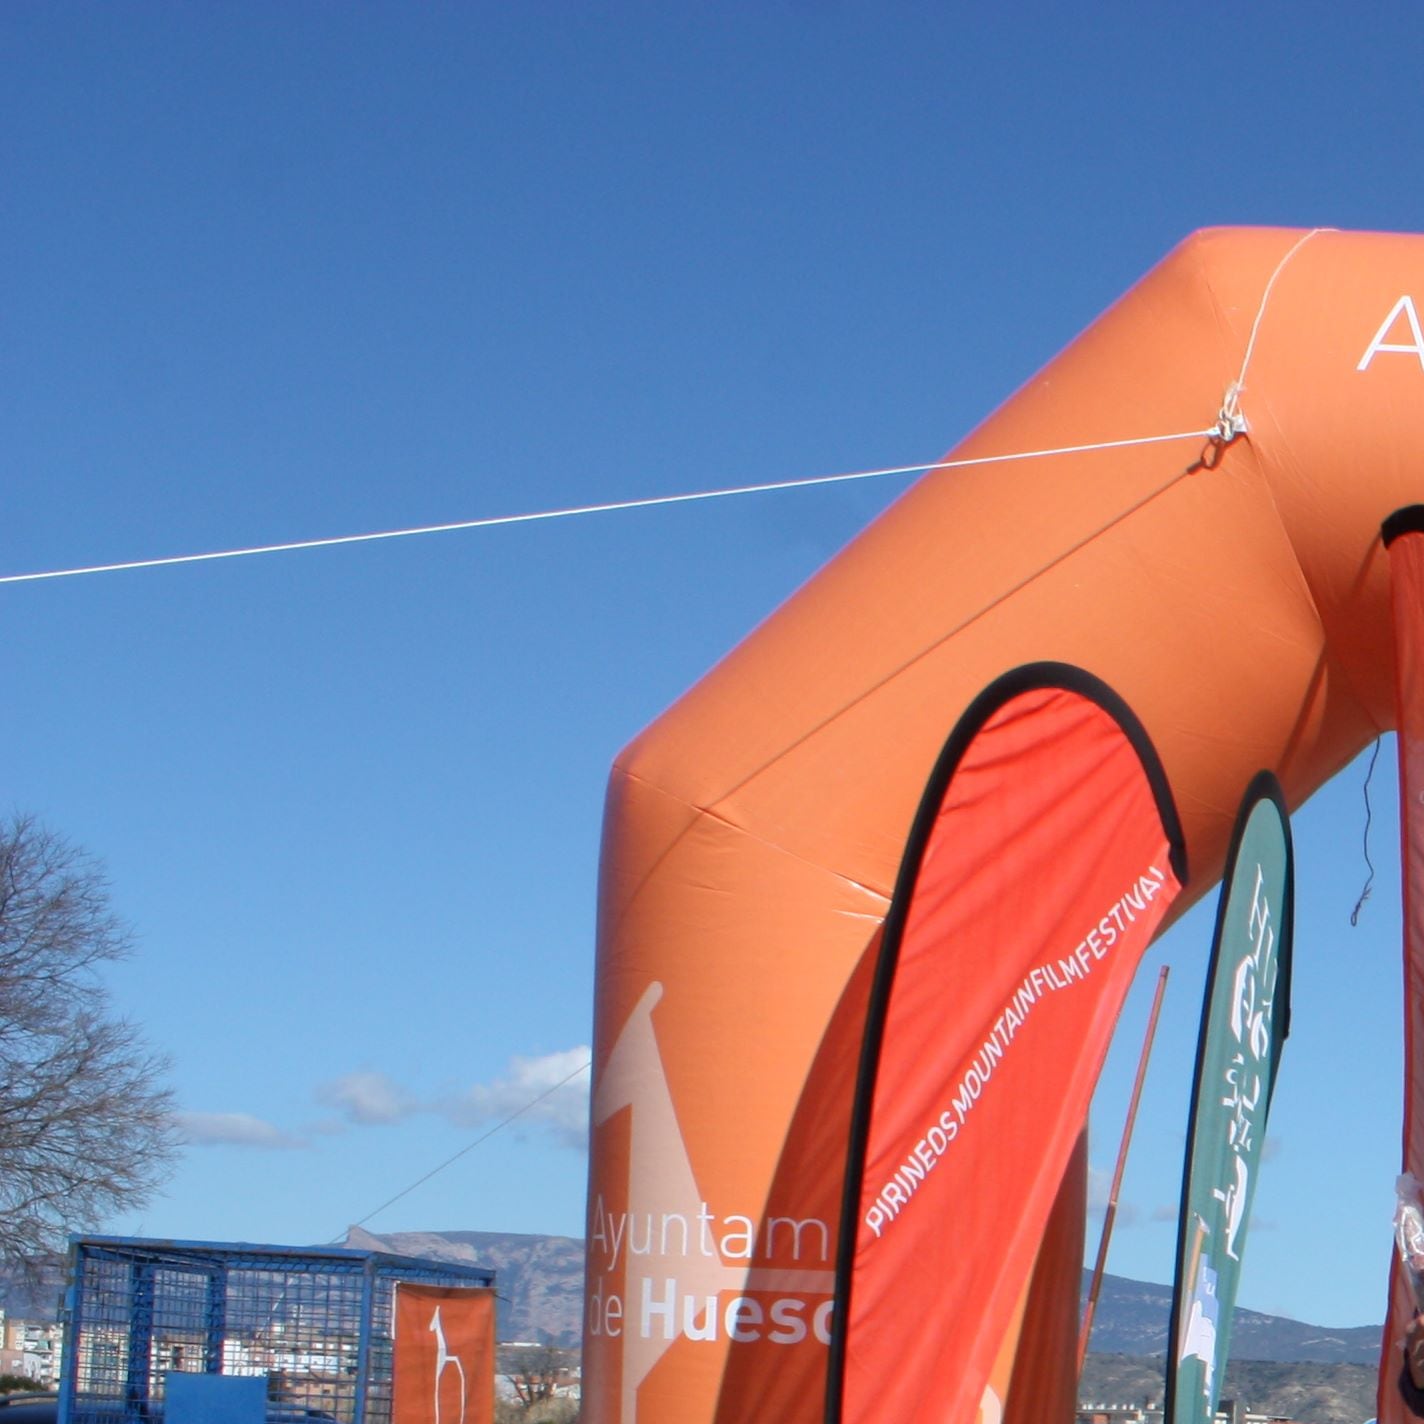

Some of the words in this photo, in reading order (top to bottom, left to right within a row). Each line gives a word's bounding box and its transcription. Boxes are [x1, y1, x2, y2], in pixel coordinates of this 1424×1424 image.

[589, 1194, 829, 1271] Ayuntam
[590, 1276, 623, 1337] de
[639, 1277, 836, 1346] Huesc
